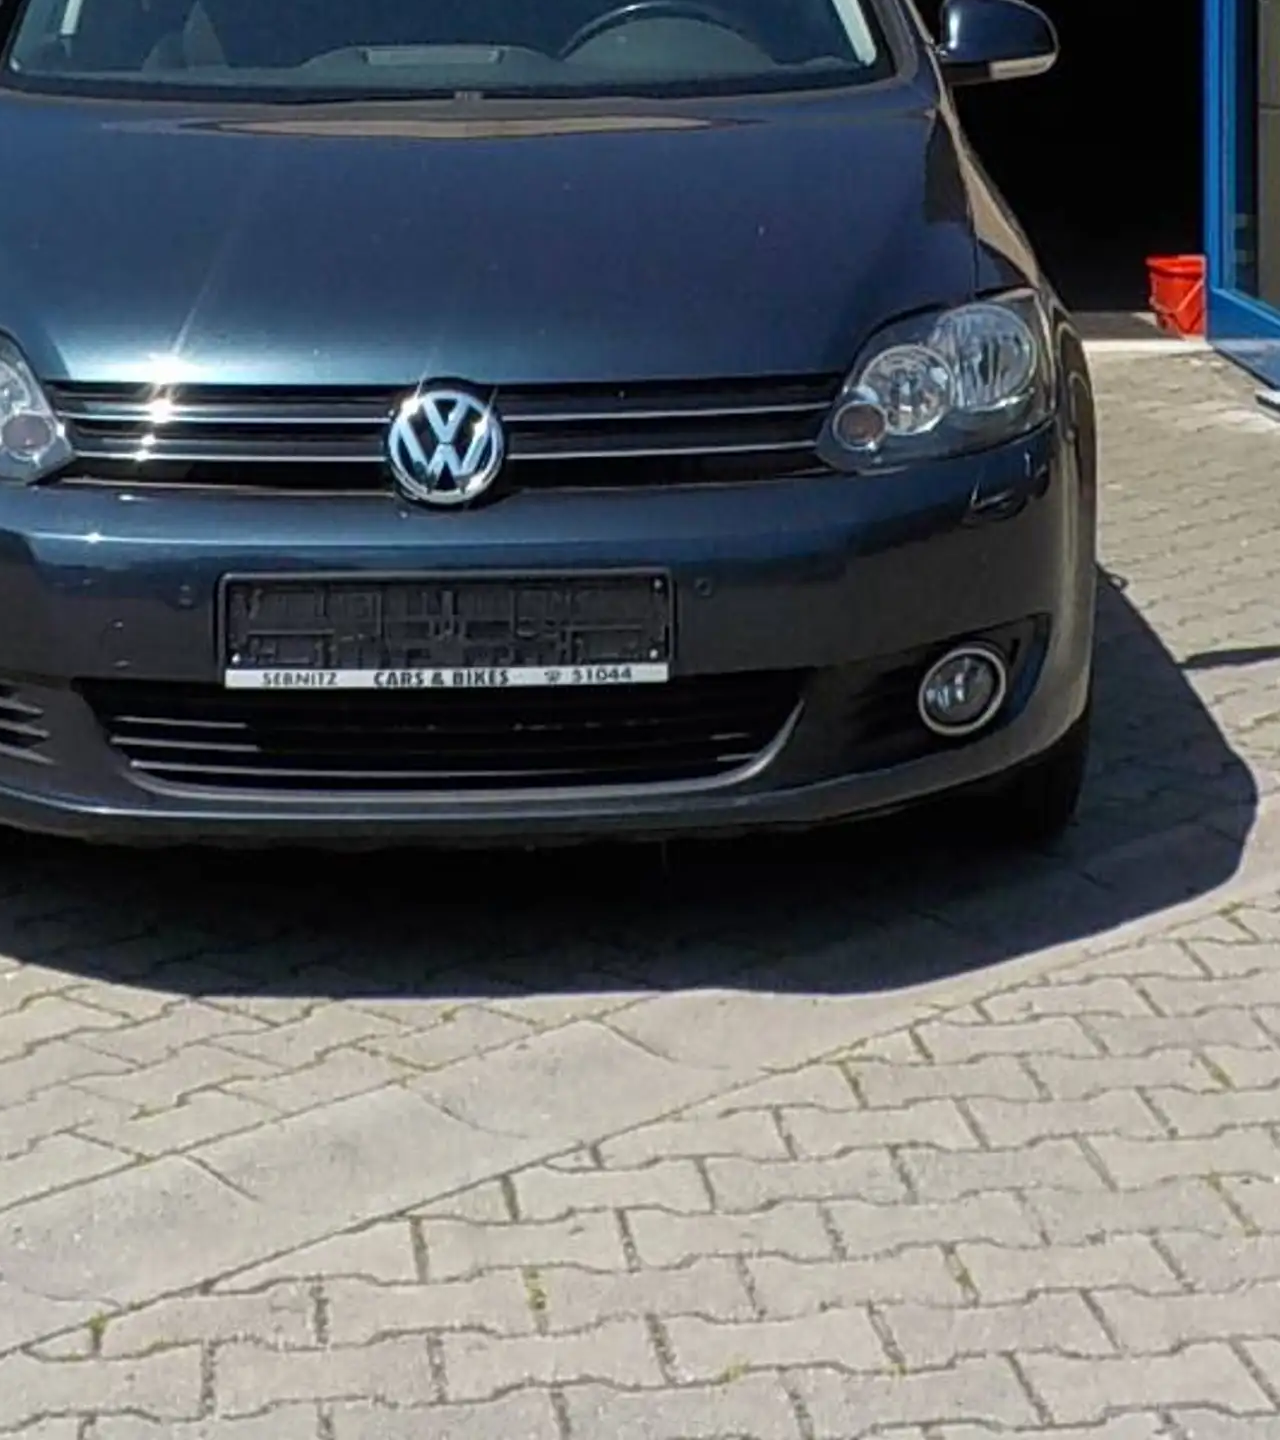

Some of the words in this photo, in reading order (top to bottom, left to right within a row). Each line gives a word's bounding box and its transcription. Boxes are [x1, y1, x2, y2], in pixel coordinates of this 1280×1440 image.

[395, 393, 496, 490] VW
[373, 670, 425, 687] CARS
[430, 671, 445, 687] &
[452, 669, 510, 687] BIKES
[571, 665, 632, 682] 51044
